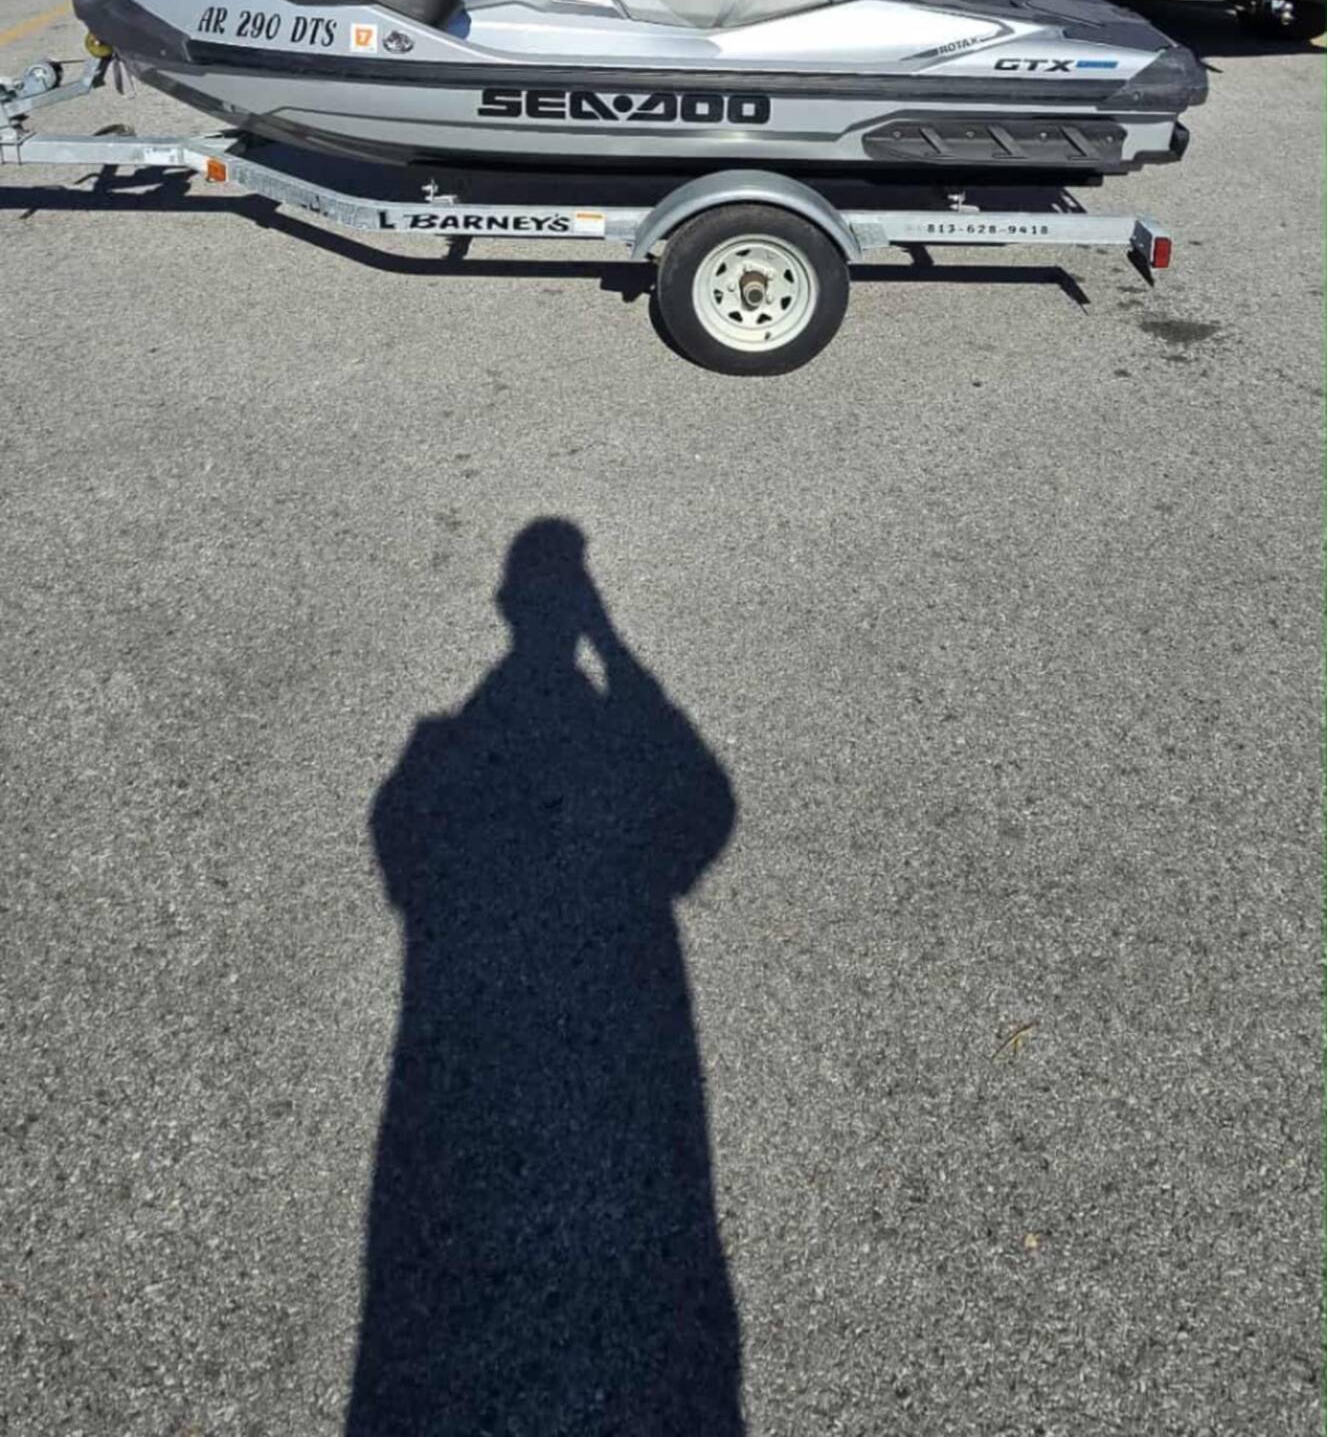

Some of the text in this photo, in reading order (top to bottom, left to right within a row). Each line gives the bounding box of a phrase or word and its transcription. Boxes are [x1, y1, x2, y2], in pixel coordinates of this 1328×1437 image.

[198, 7, 337, 47] AR 290 DTS
[994, 59, 1075, 72] GTX
[403, 213, 570, 232] BARNEY'S
